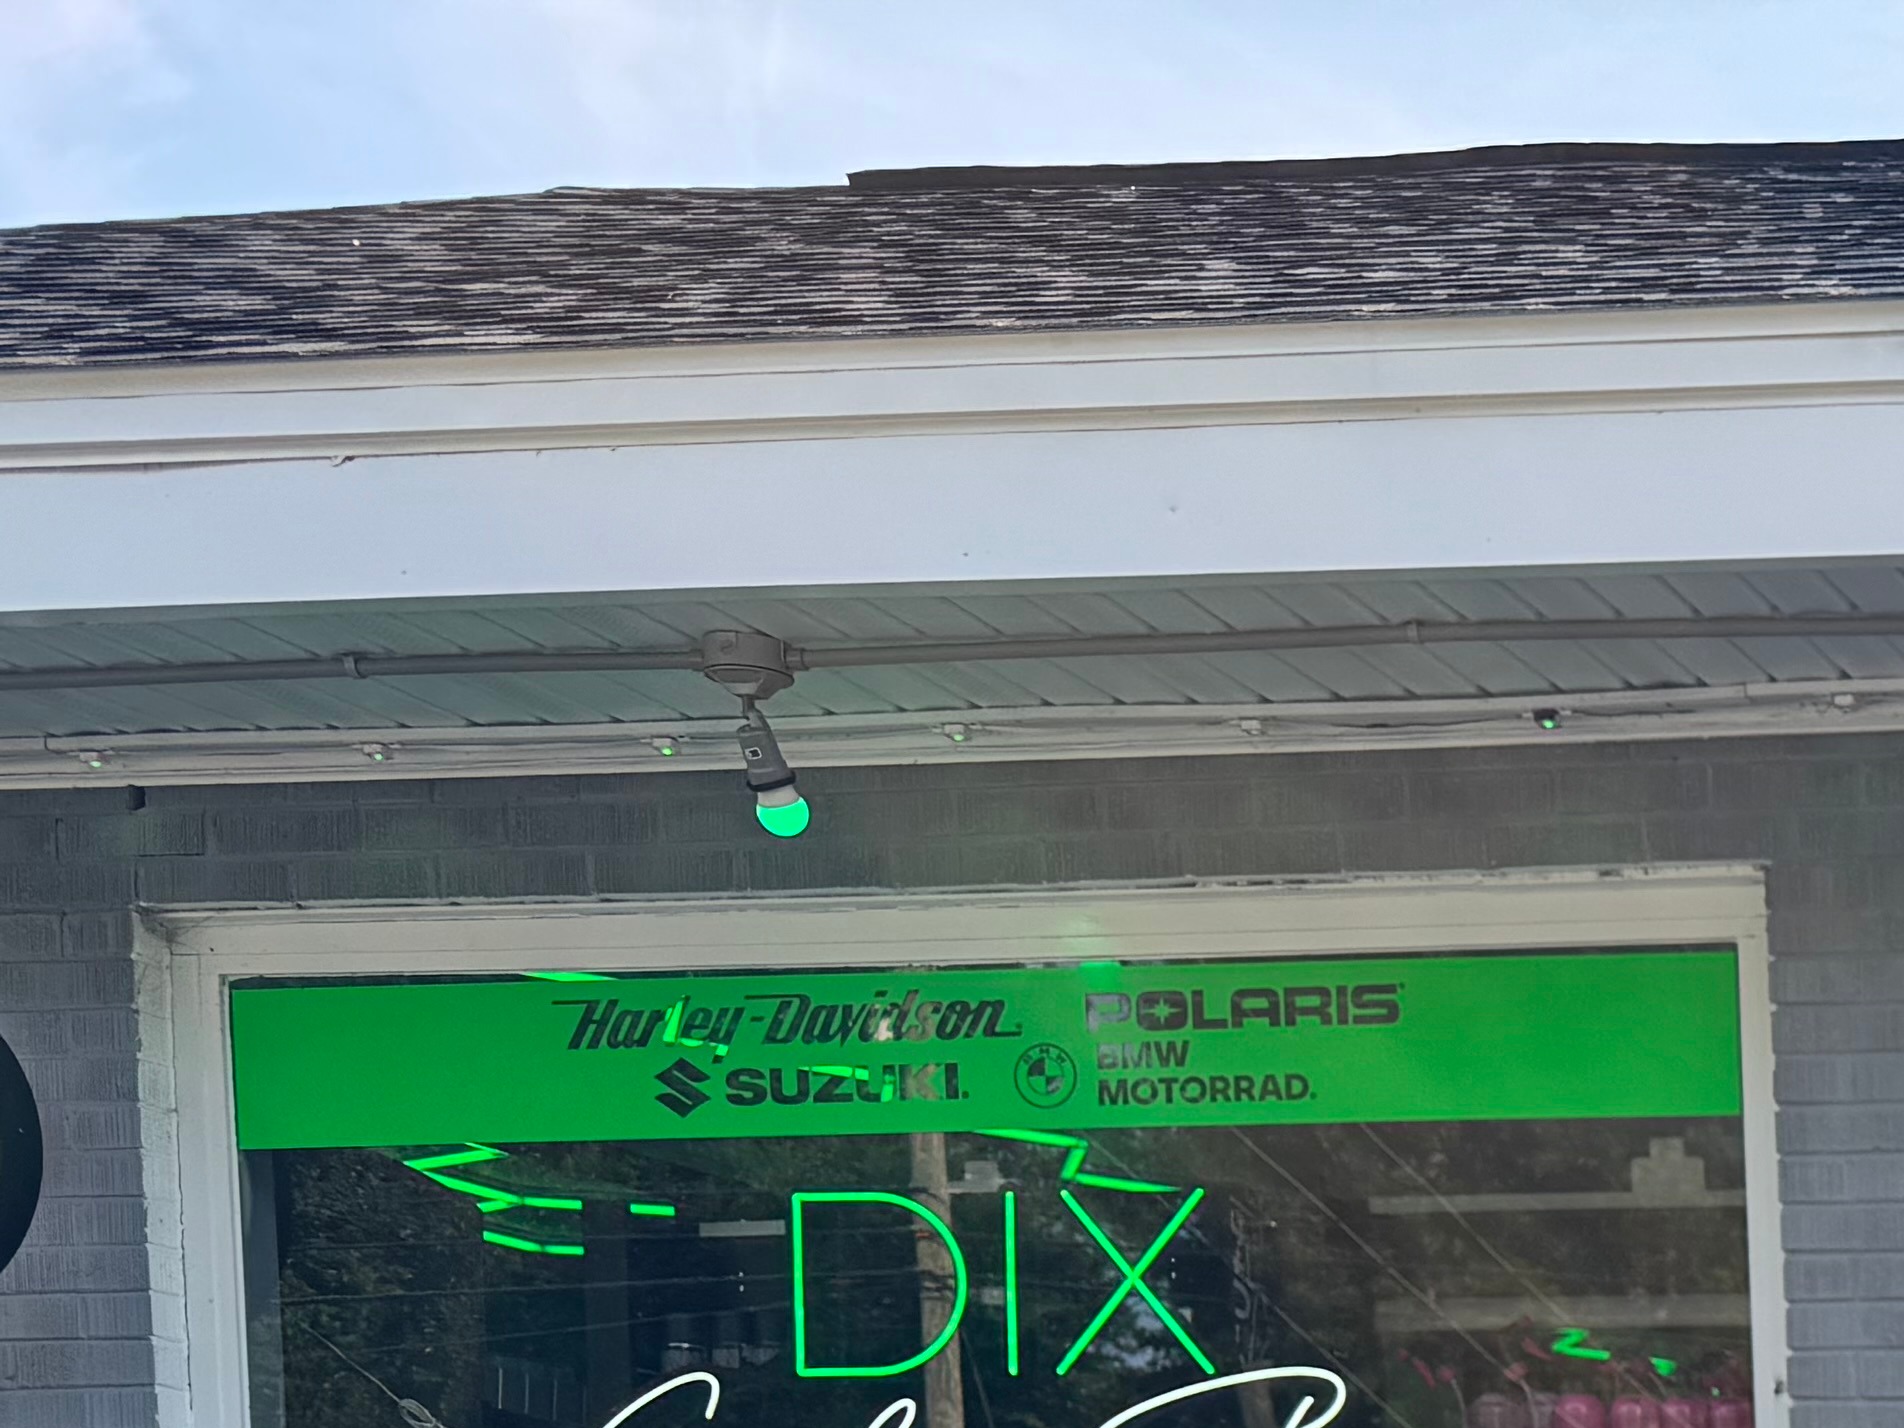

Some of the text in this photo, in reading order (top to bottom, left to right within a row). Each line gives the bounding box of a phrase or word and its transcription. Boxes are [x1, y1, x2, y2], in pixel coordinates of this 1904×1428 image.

[1085, 984, 1399, 1031] POLARIS
[1098, 1040, 1190, 1070] BMW
[792, 1187, 1216, 1378] DIX
